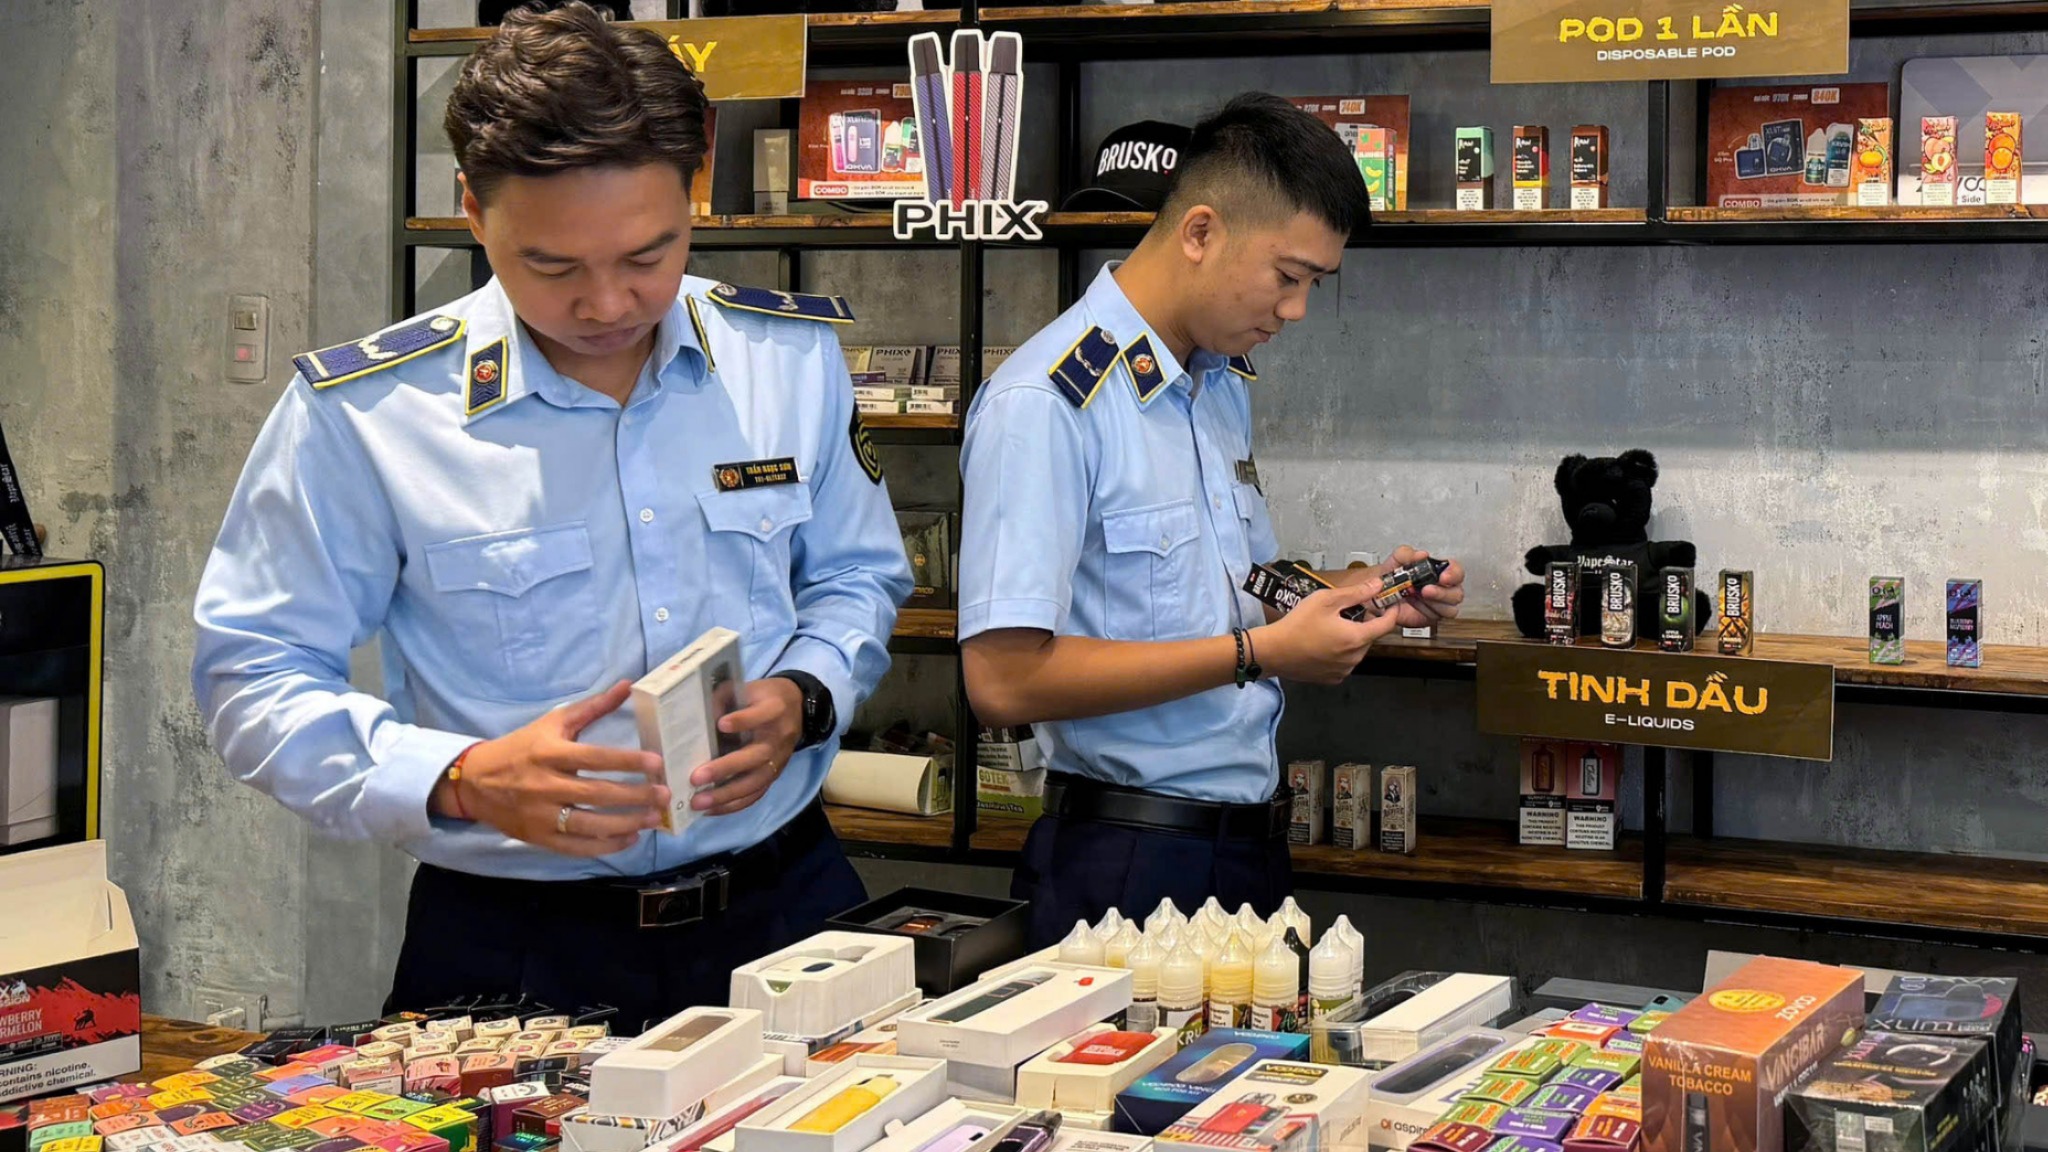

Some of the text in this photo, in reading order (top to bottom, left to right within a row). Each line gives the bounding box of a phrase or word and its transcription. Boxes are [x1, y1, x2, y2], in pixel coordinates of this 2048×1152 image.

[1558, 3, 1778, 43] POD 1 LẦN
[1597, 46, 1736, 61] DISPOSABLE POD
[1096, 140, 1178, 177] BRUSKO
[814, 185, 848, 194] COMBO
[897, 203, 1040, 236] PHIX
[875, 348, 905, 356] PHIX
[1552, 570, 1566, 608] BRUSKO
[1609, 572, 1623, 610] BRUSKO
[1667, 575, 1681, 613] BRUSKO
[1726, 577, 1740, 616] BRUSKO
[1537, 669, 1768, 715] TINH DẦU
[1605, 713, 1695, 731] E-LIQUIDS
[1573, 815, 1607, 823] WARNING
[45, 1062, 91, 1078] nicotine.
[46, 1069, 97, 1088] chemical.
[1647, 1055, 1752, 1083] VANILLA CREAM
[1669, 1075, 1733, 1096] TOBACCO
